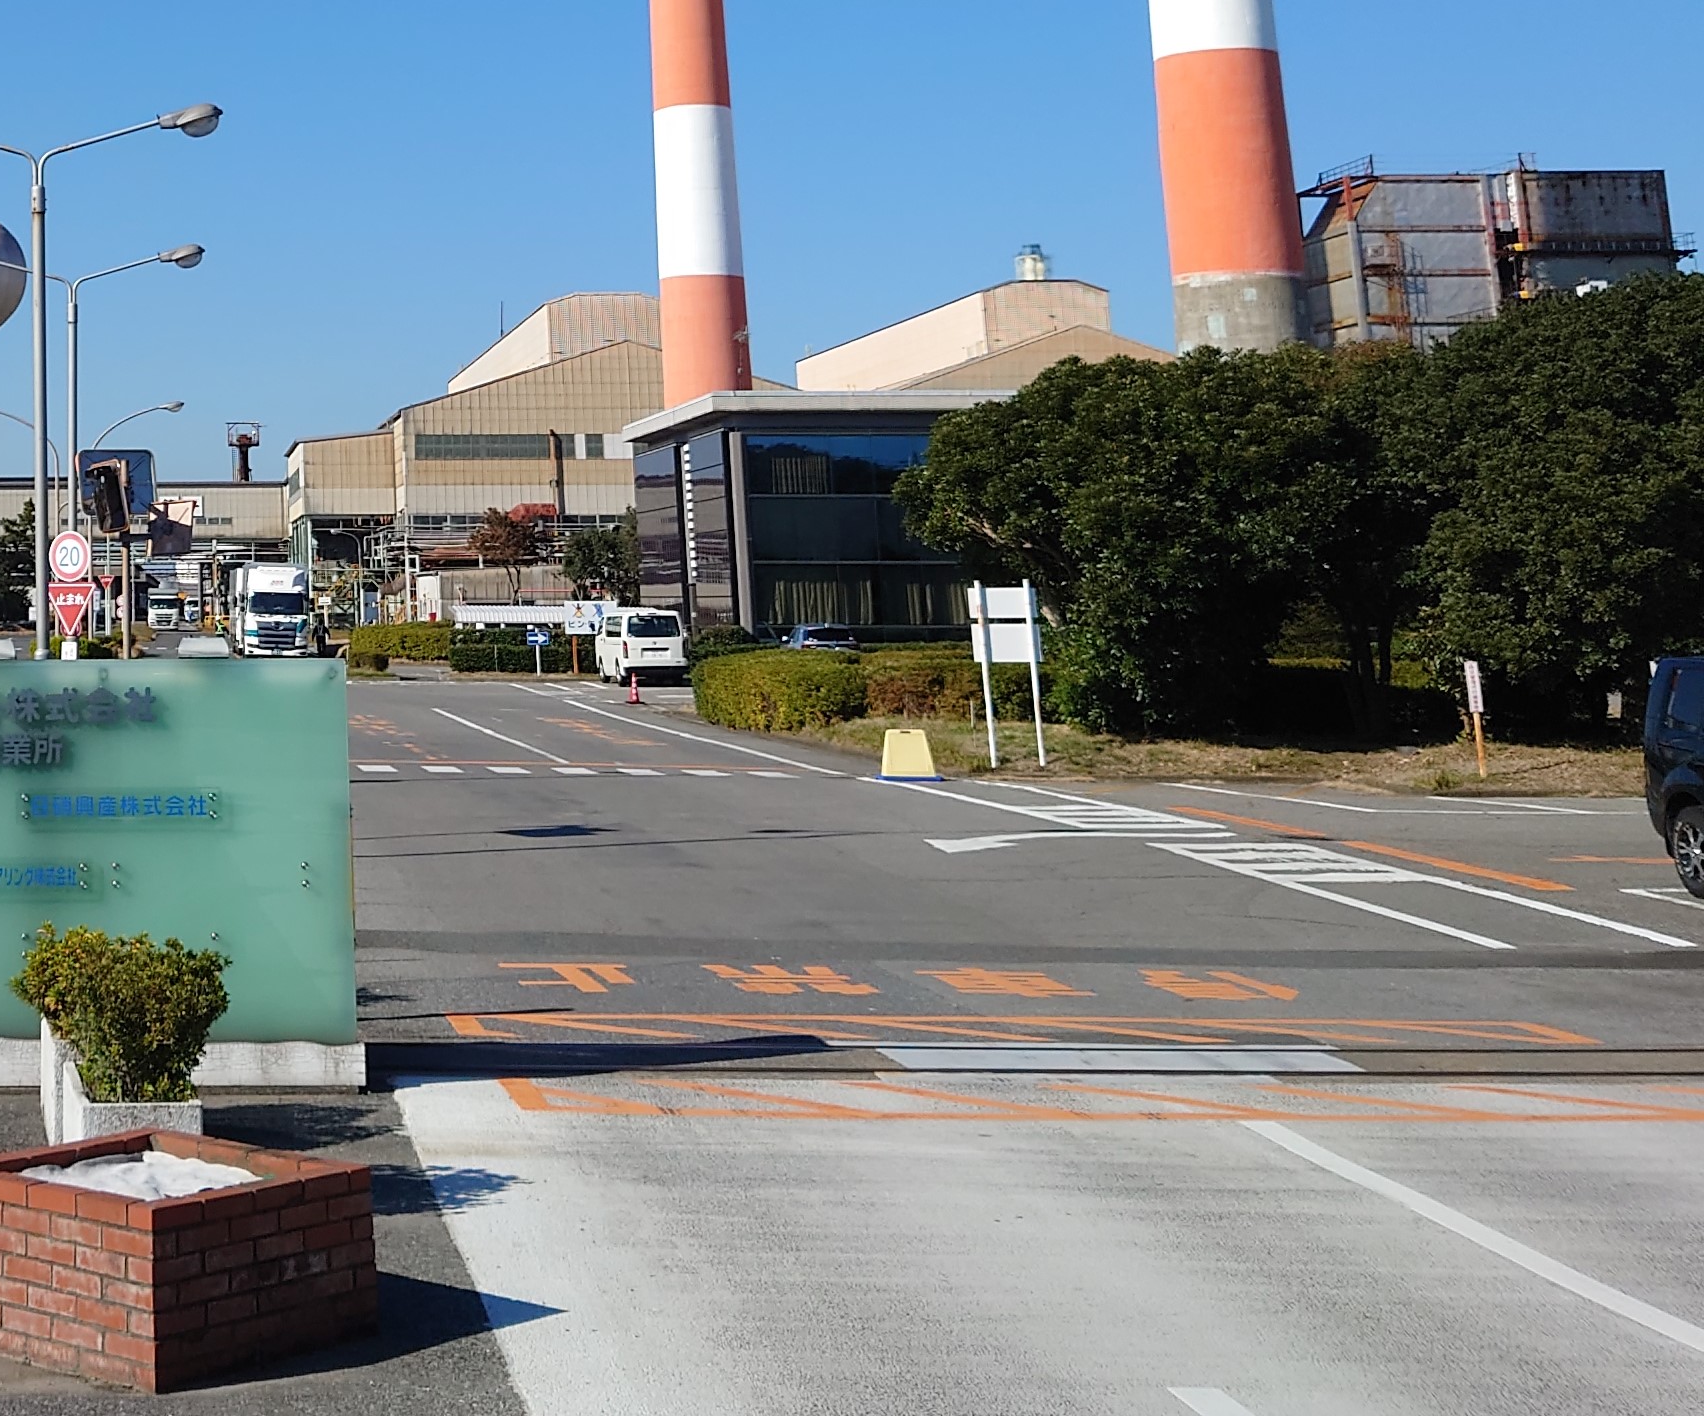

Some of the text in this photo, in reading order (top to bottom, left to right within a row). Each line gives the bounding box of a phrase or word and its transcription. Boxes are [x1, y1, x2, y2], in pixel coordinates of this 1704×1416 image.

[59, 546, 80, 567] 20
[56, 593, 85, 606] 止まれ
